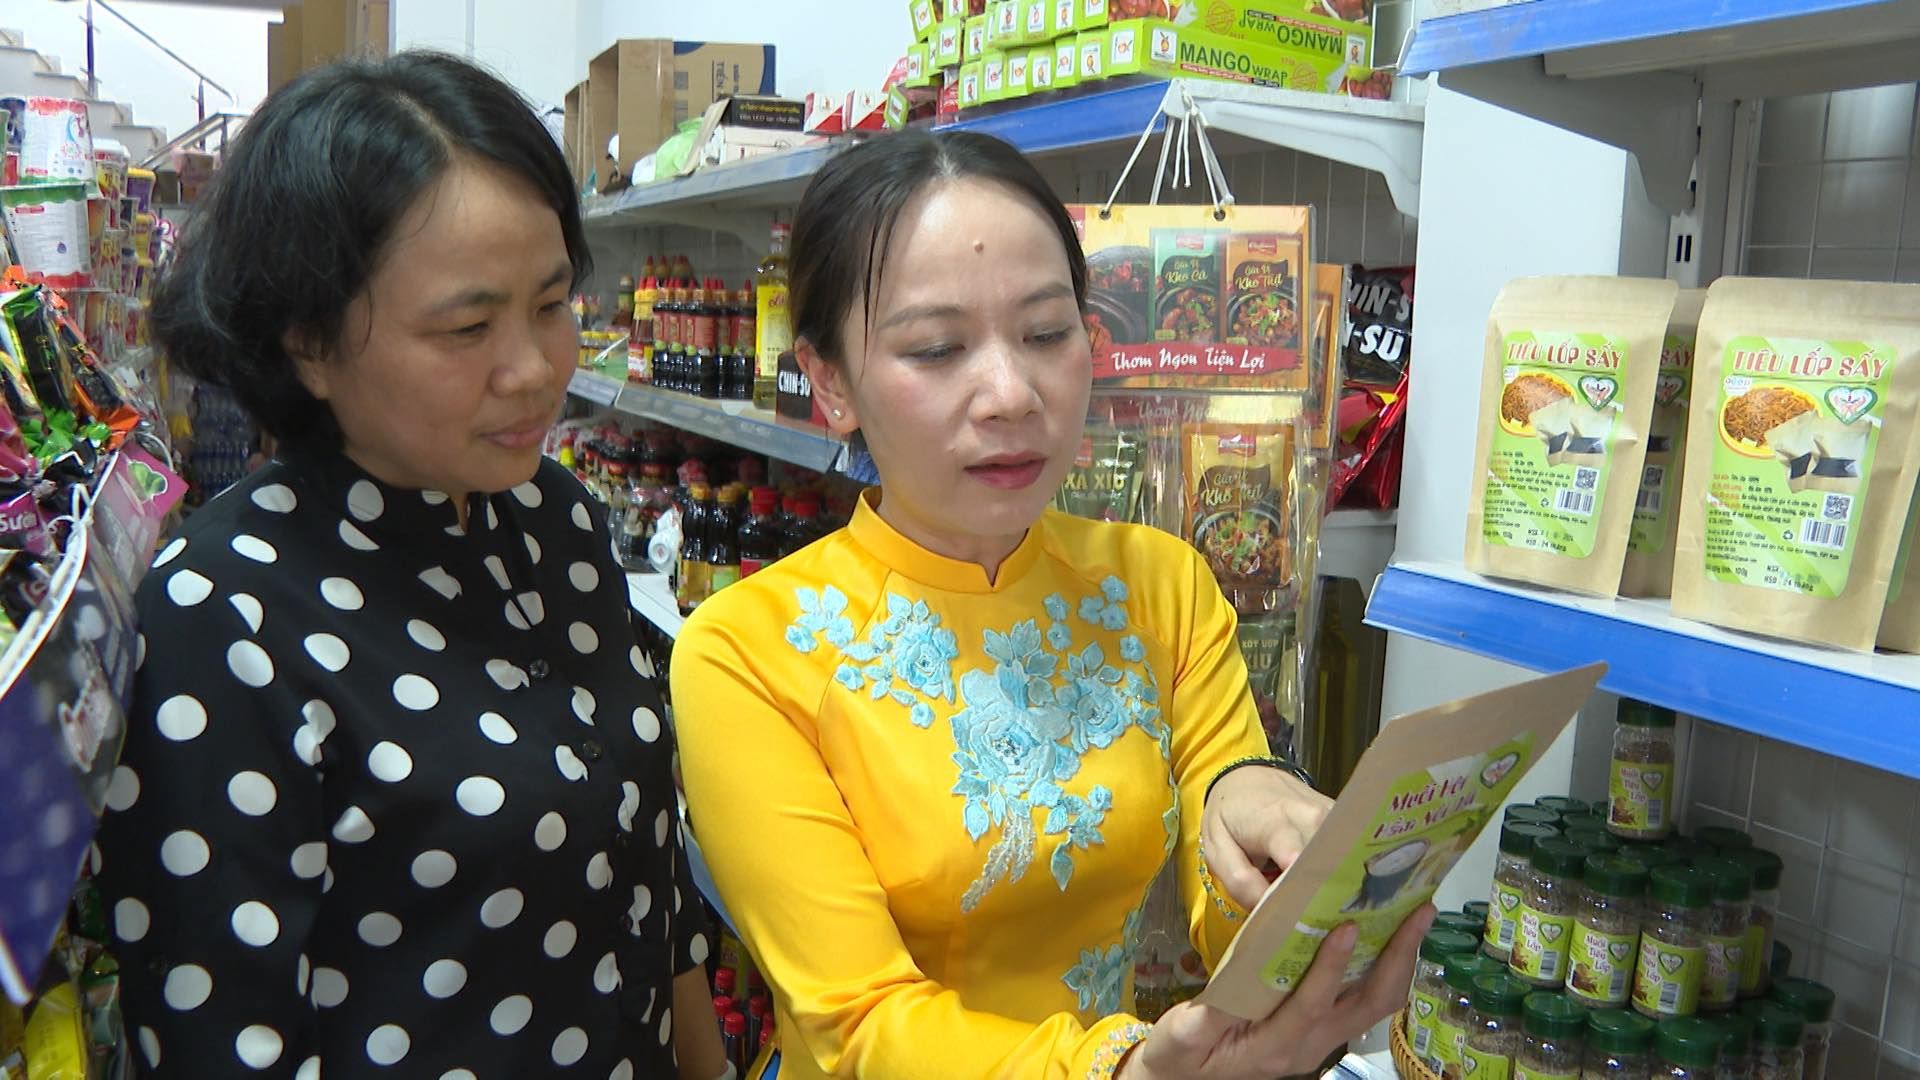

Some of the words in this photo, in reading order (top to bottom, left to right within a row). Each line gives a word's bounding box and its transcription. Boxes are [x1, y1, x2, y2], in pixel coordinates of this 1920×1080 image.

[1277, 25, 1343, 55] MANGO
[1180, 42, 1250, 74] MANGO
[1251, 65, 1288, 87] WRAP
[1112, 351, 1152, 371] Thơm
[1159, 347, 1198, 370] Ngon
[1205, 346, 1235, 373] Tiện
[1239, 349, 1266, 374] Lợi
[1547, 337, 1580, 364] LỐP
[1585, 341, 1624, 370] SẤY
[1733, 348, 1784, 373] TIÊU
[1790, 346, 1833, 376] LỐP
[1838, 349, 1888, 379] SẤY
